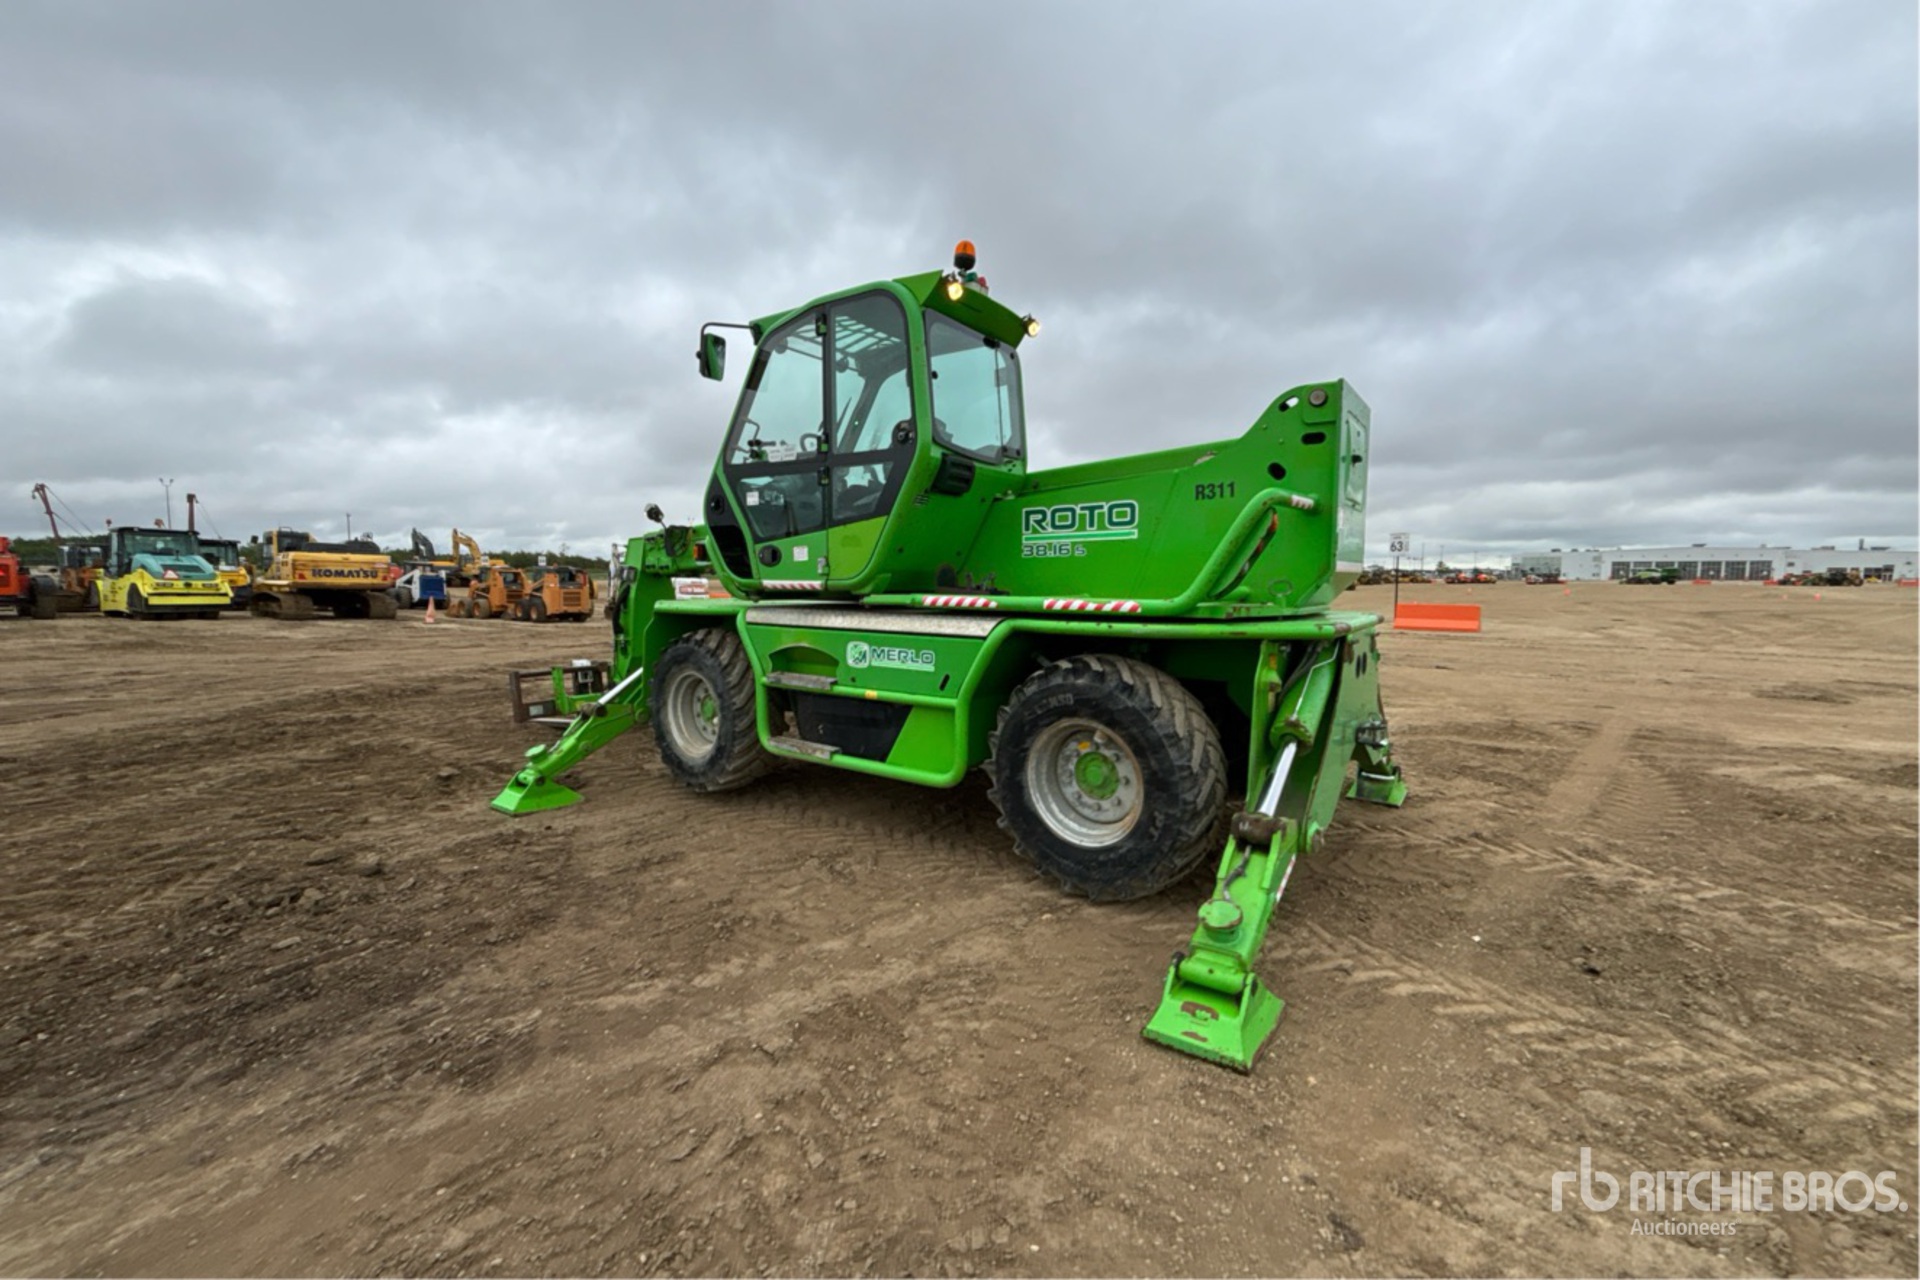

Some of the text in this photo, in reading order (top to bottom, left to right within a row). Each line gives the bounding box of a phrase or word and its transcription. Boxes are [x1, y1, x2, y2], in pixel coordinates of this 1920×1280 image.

[1194, 481, 1236, 500] R311
[1022, 499, 1139, 534] ROTO
[1022, 541, 1071, 557] 38.16
[1390, 540, 1404, 552] 63
[311, 568, 379, 579] KOMATSU
[871, 646, 935, 666] MERLO
